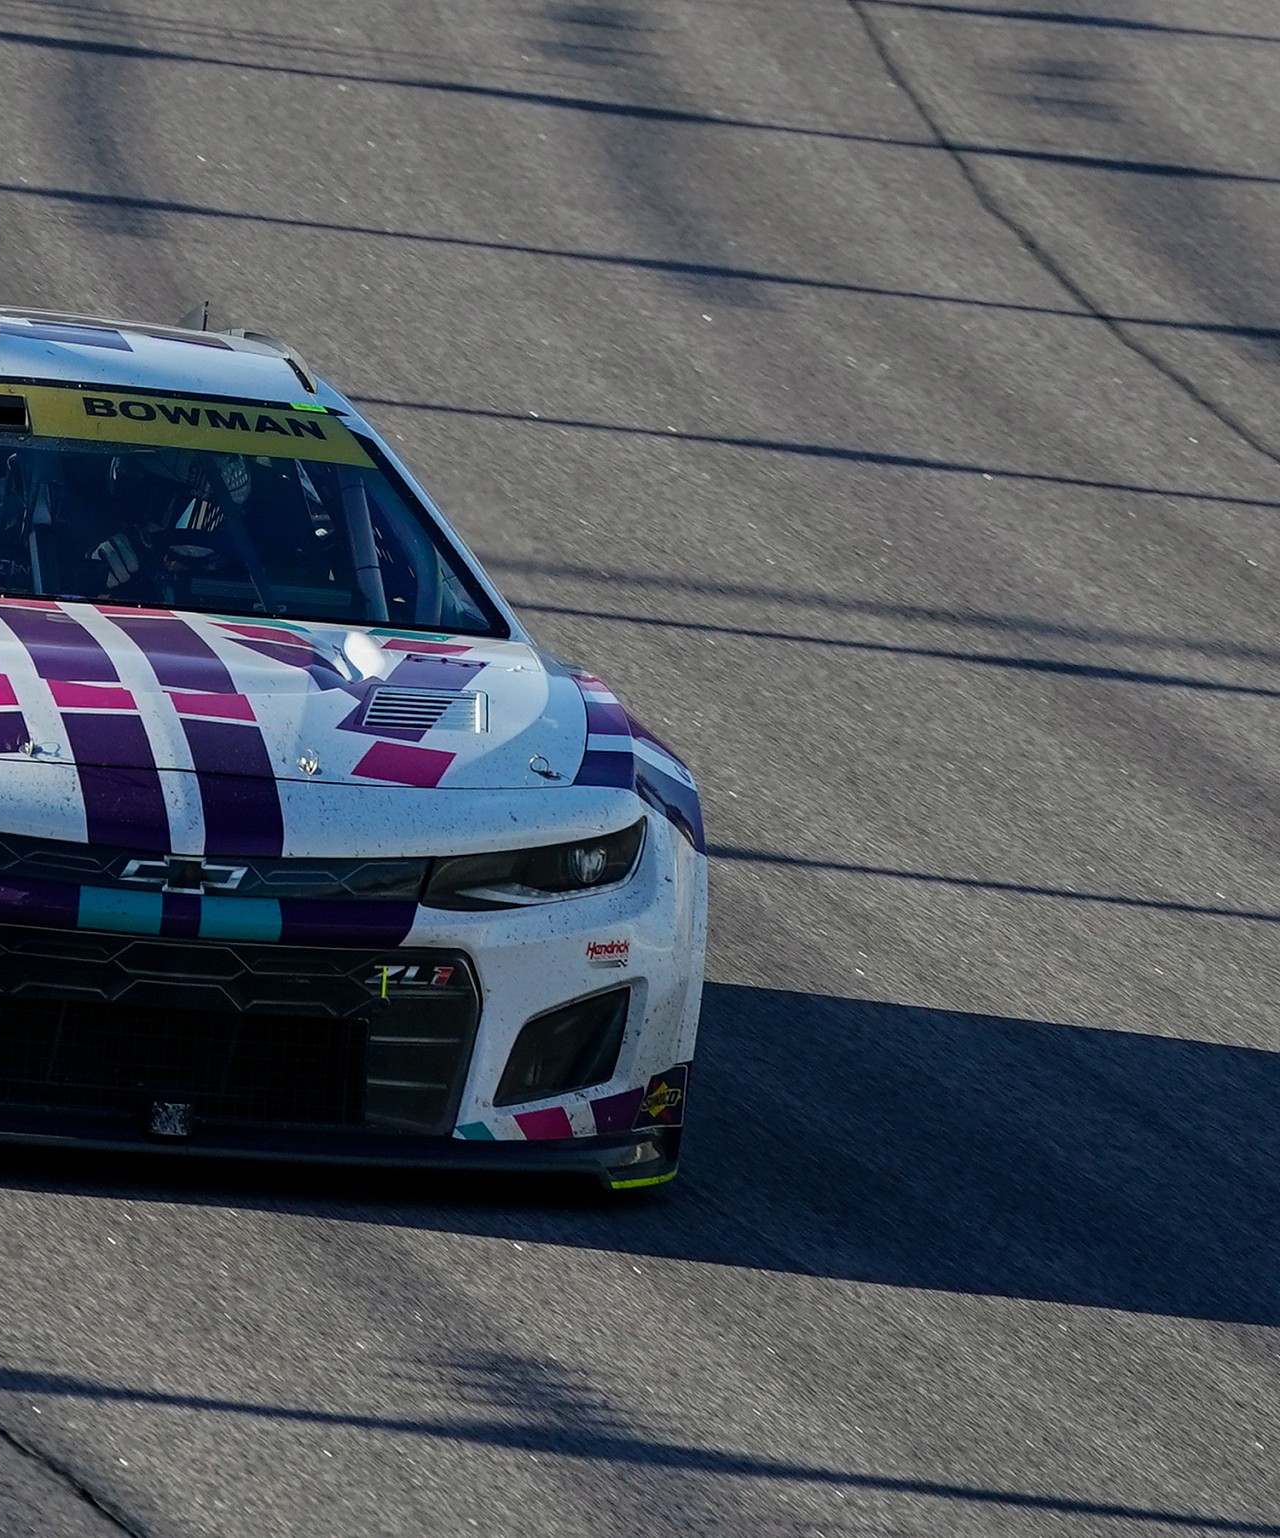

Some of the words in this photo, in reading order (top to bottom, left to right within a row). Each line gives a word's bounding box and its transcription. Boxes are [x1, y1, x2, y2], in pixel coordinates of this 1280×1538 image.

[82, 396, 328, 441] BOWMAN
[586, 940, 630, 960] Hendrick
[364, 965, 455, 986] ZL1
